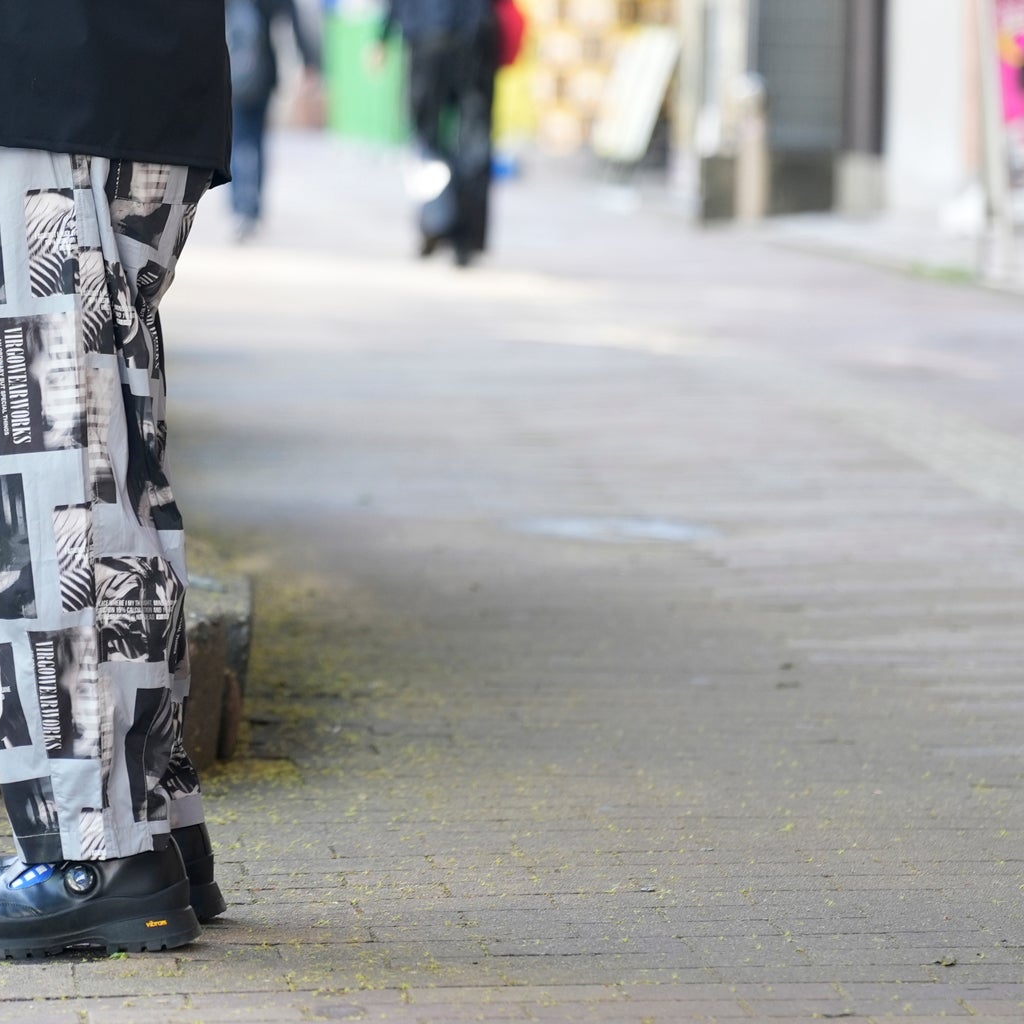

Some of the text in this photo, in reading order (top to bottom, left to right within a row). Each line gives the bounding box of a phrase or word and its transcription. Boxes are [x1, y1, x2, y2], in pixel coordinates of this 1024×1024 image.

[4, 327, 31, 445] VIRGOWEARWORKS
[35, 641, 62, 750] VIRGOWEARWORKS
[146, 920, 168, 928] vibram
